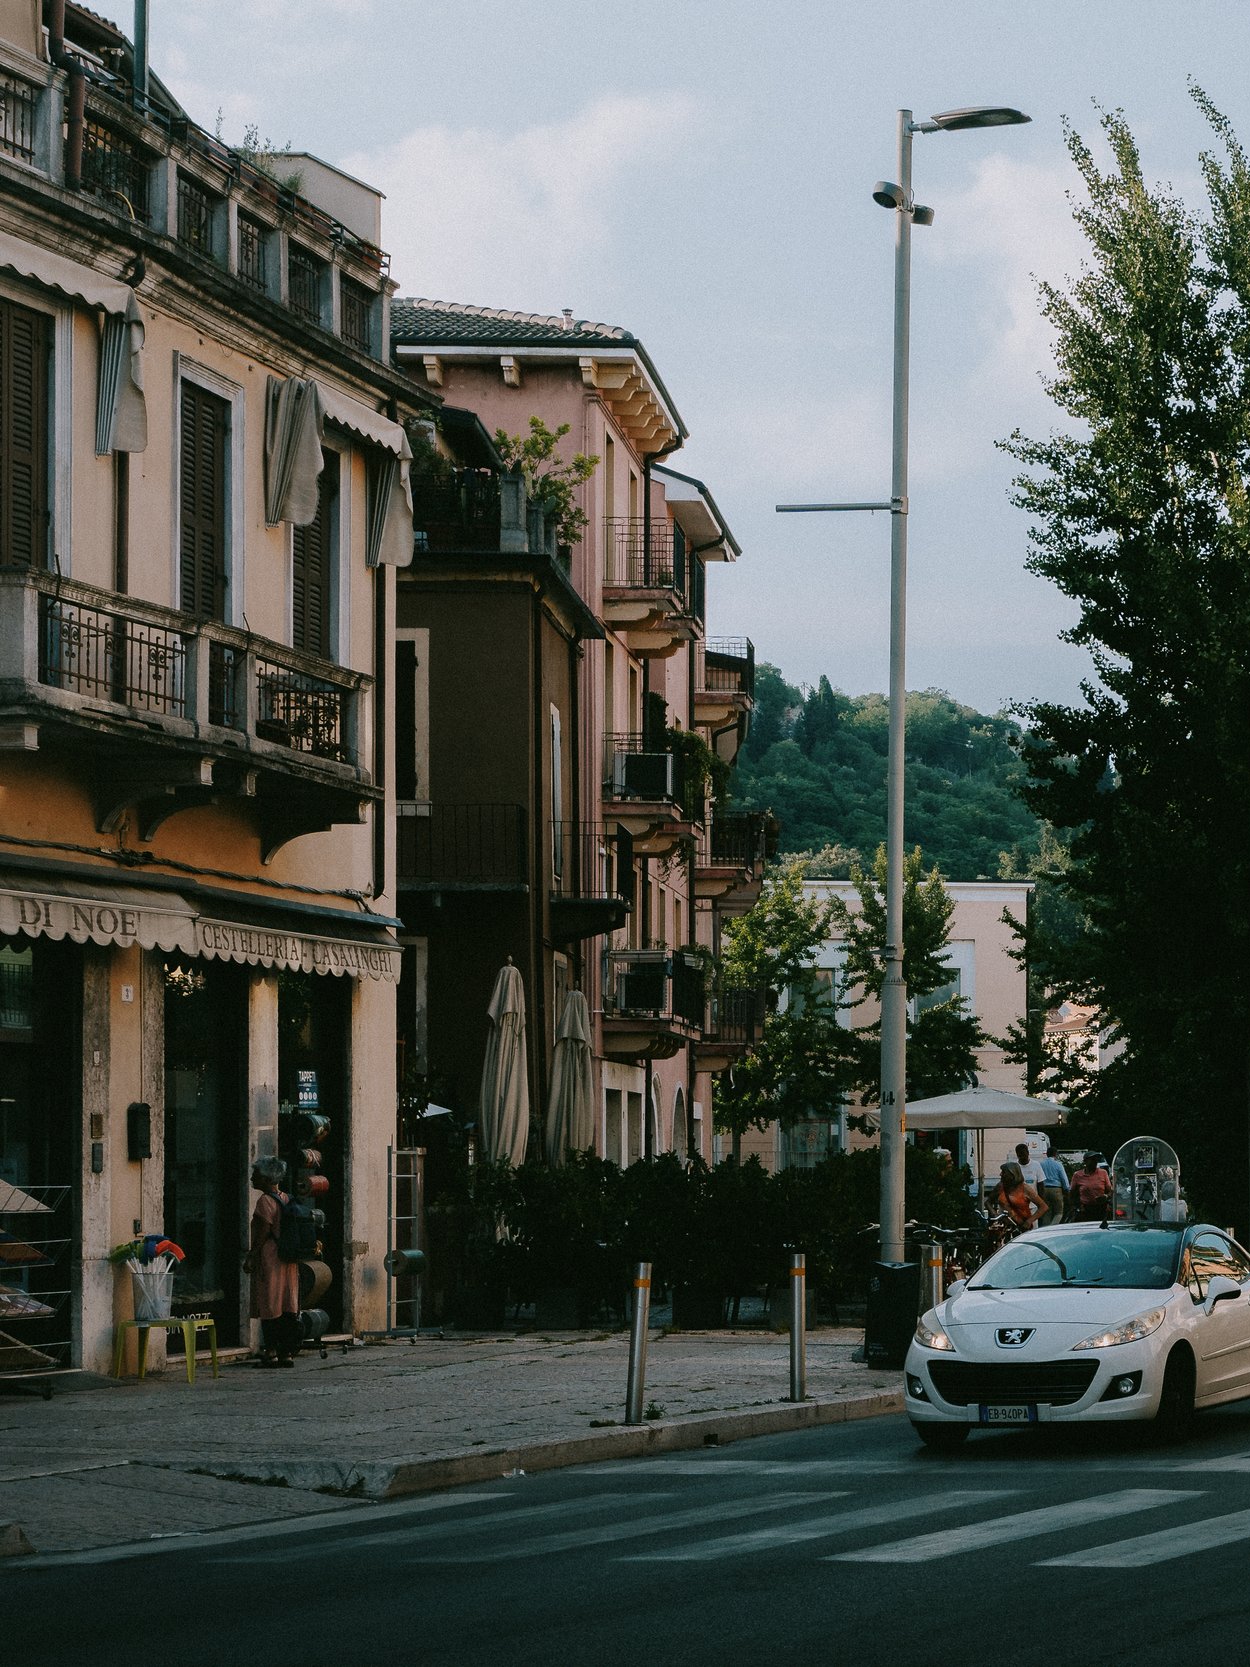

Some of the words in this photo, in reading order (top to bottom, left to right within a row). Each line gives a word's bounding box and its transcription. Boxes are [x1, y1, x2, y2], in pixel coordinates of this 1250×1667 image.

[19, 898, 54, 928] DI
[202, 924, 300, 961] CESTELLERIA
[313, 941, 393, 973] CASALINGHI
